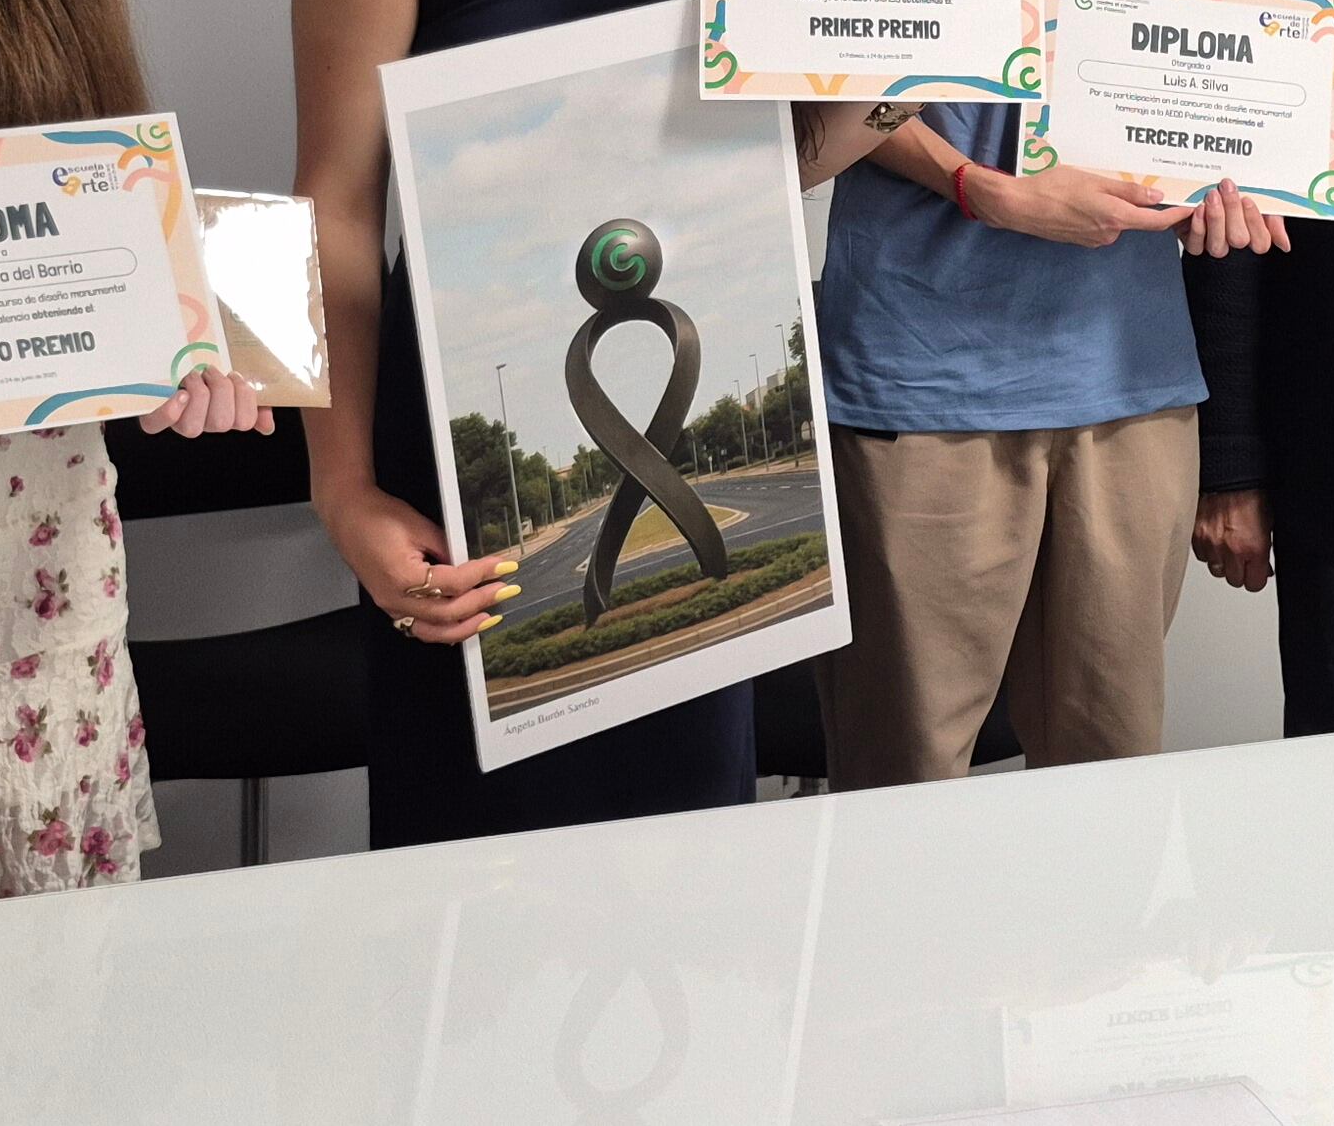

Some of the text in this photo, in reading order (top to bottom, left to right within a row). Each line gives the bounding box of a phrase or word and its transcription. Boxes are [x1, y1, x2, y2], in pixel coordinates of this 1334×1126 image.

[810, 16, 941, 40] PRIMER PREMIO
[1131, 22, 1254, 63] DIPLOMA
[1171, 60, 1204, 71] Otorgado
[1163, 74, 1229, 92] Luis A. Silva
[1089, 88, 1101, 96] Por
[1103, 90, 1112, 98] su
[1113, 91, 1160, 104] participación
[1171, 97, 1178, 105] el
[1180, 100, 1212, 110] concurso
[1214, 102, 1223, 110] de
[1224, 103, 1248, 114] diseño
[1248, 108, 1292, 118] monumental
[1115, 104, 1149, 116] homenaje
[1184, 112, 1215, 122] Palencia
[1216, 115, 1255, 127] obteniendo
[1125, 125, 1253, 157] TERCER PREMIO
[92, 171, 105, 179] de
[13, 264, 35, 281] del
[38, 259, 83, 278] Barrio
[24, 293, 37, 304] de
[38, 290, 69, 304] diseño
[70, 282, 127, 298] monumental
[31, 305, 83, 321] obteniendo
[15, 330, 96, 362] PREMIO
[504, 697, 600, 735] Ángela Burón Sancho
